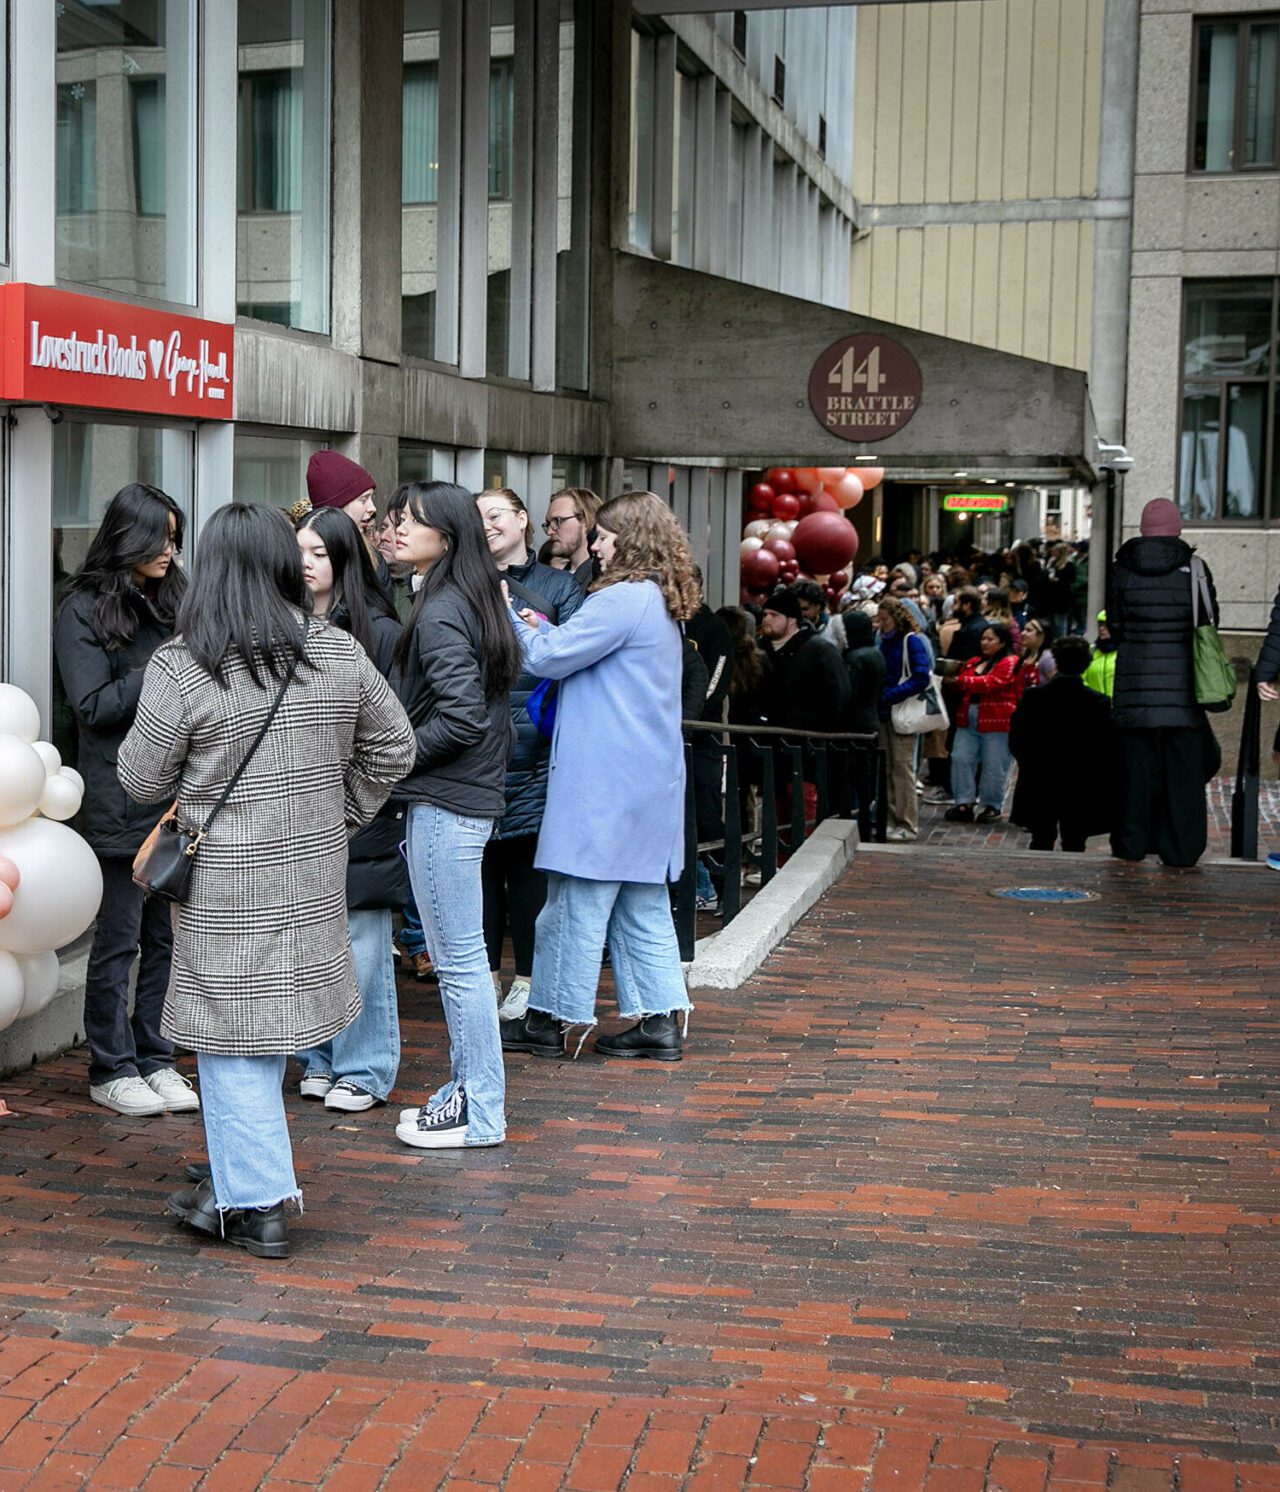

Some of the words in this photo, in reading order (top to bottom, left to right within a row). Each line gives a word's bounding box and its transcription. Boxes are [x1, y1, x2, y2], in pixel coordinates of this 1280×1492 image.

[30, 320, 108, 375] Lovestruck
[107, 333, 147, 380] Books
[828, 346, 886, 393] 44
[826, 411, 901, 426] STREET
[827, 396, 915, 410] BRATTLE
